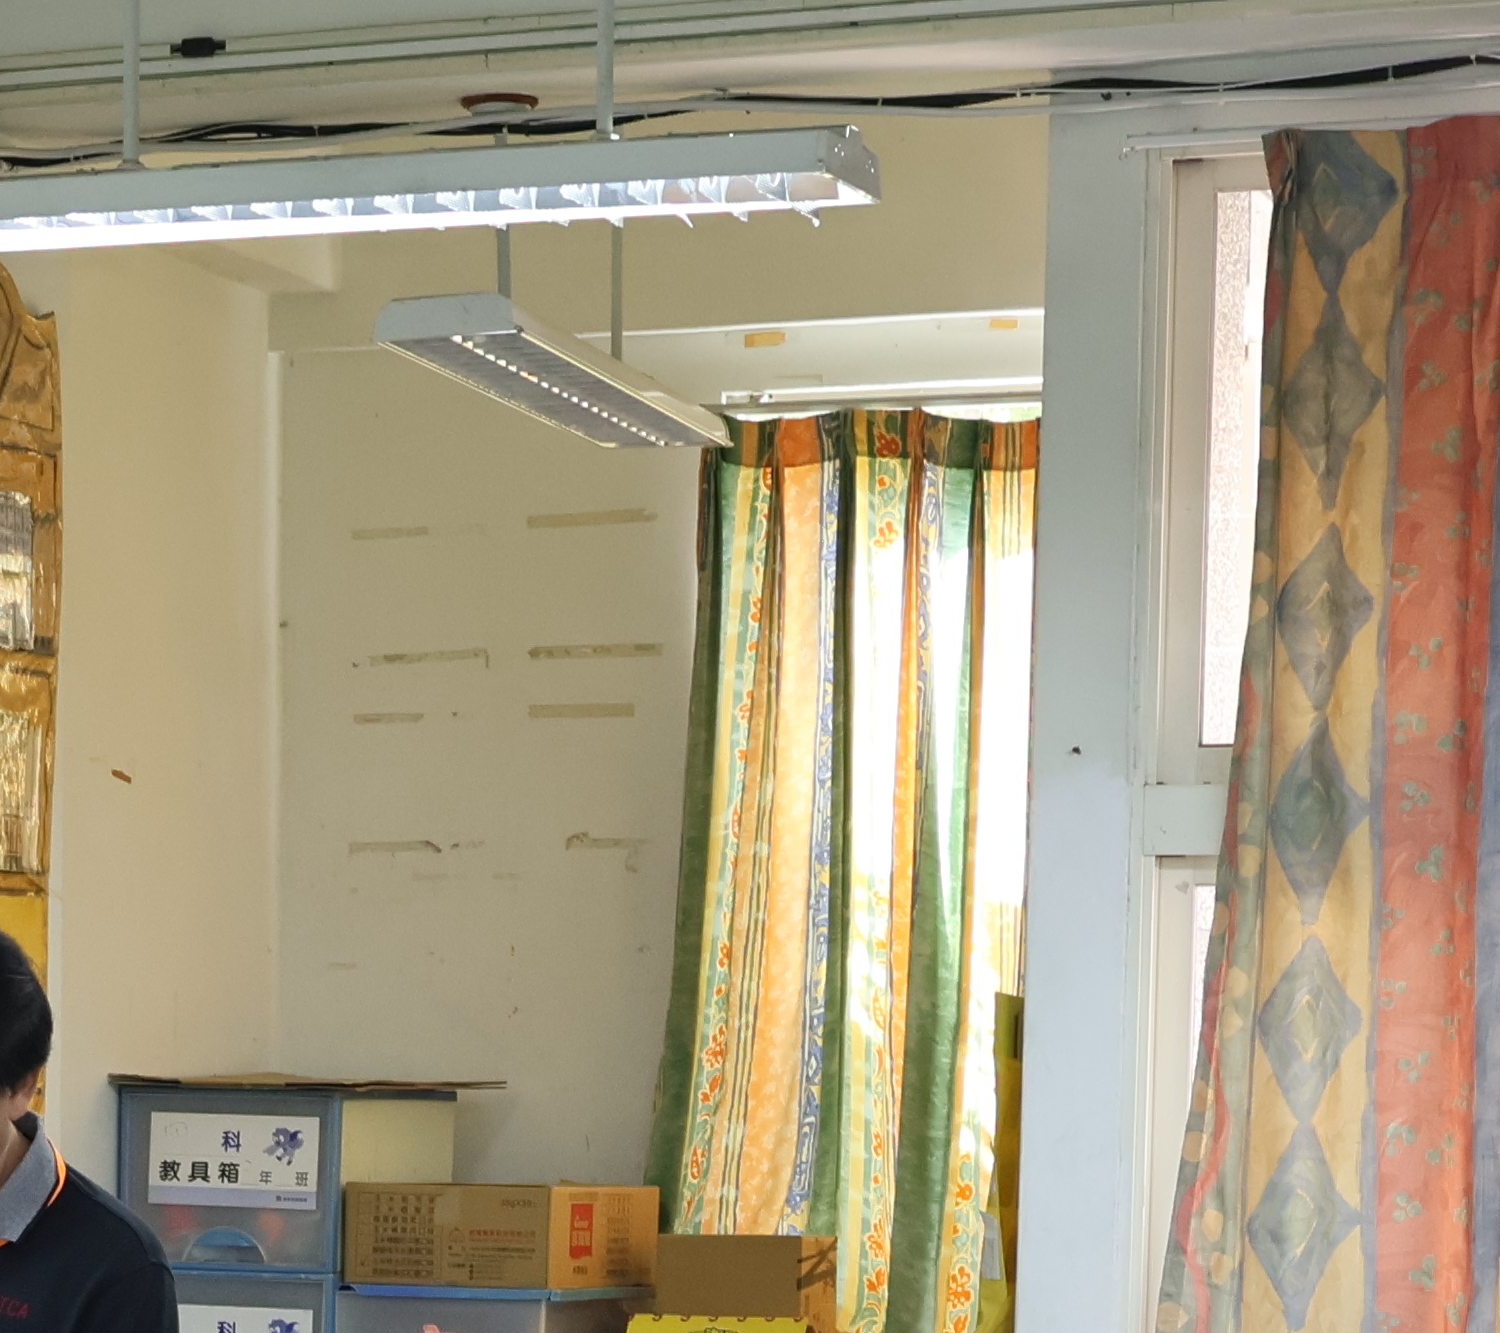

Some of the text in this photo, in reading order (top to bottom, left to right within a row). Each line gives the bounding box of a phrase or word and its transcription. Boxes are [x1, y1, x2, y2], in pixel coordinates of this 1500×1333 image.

[221, 1130, 241, 1152] 科
[158, 1159, 308, 1187] 教具箱 年 班
